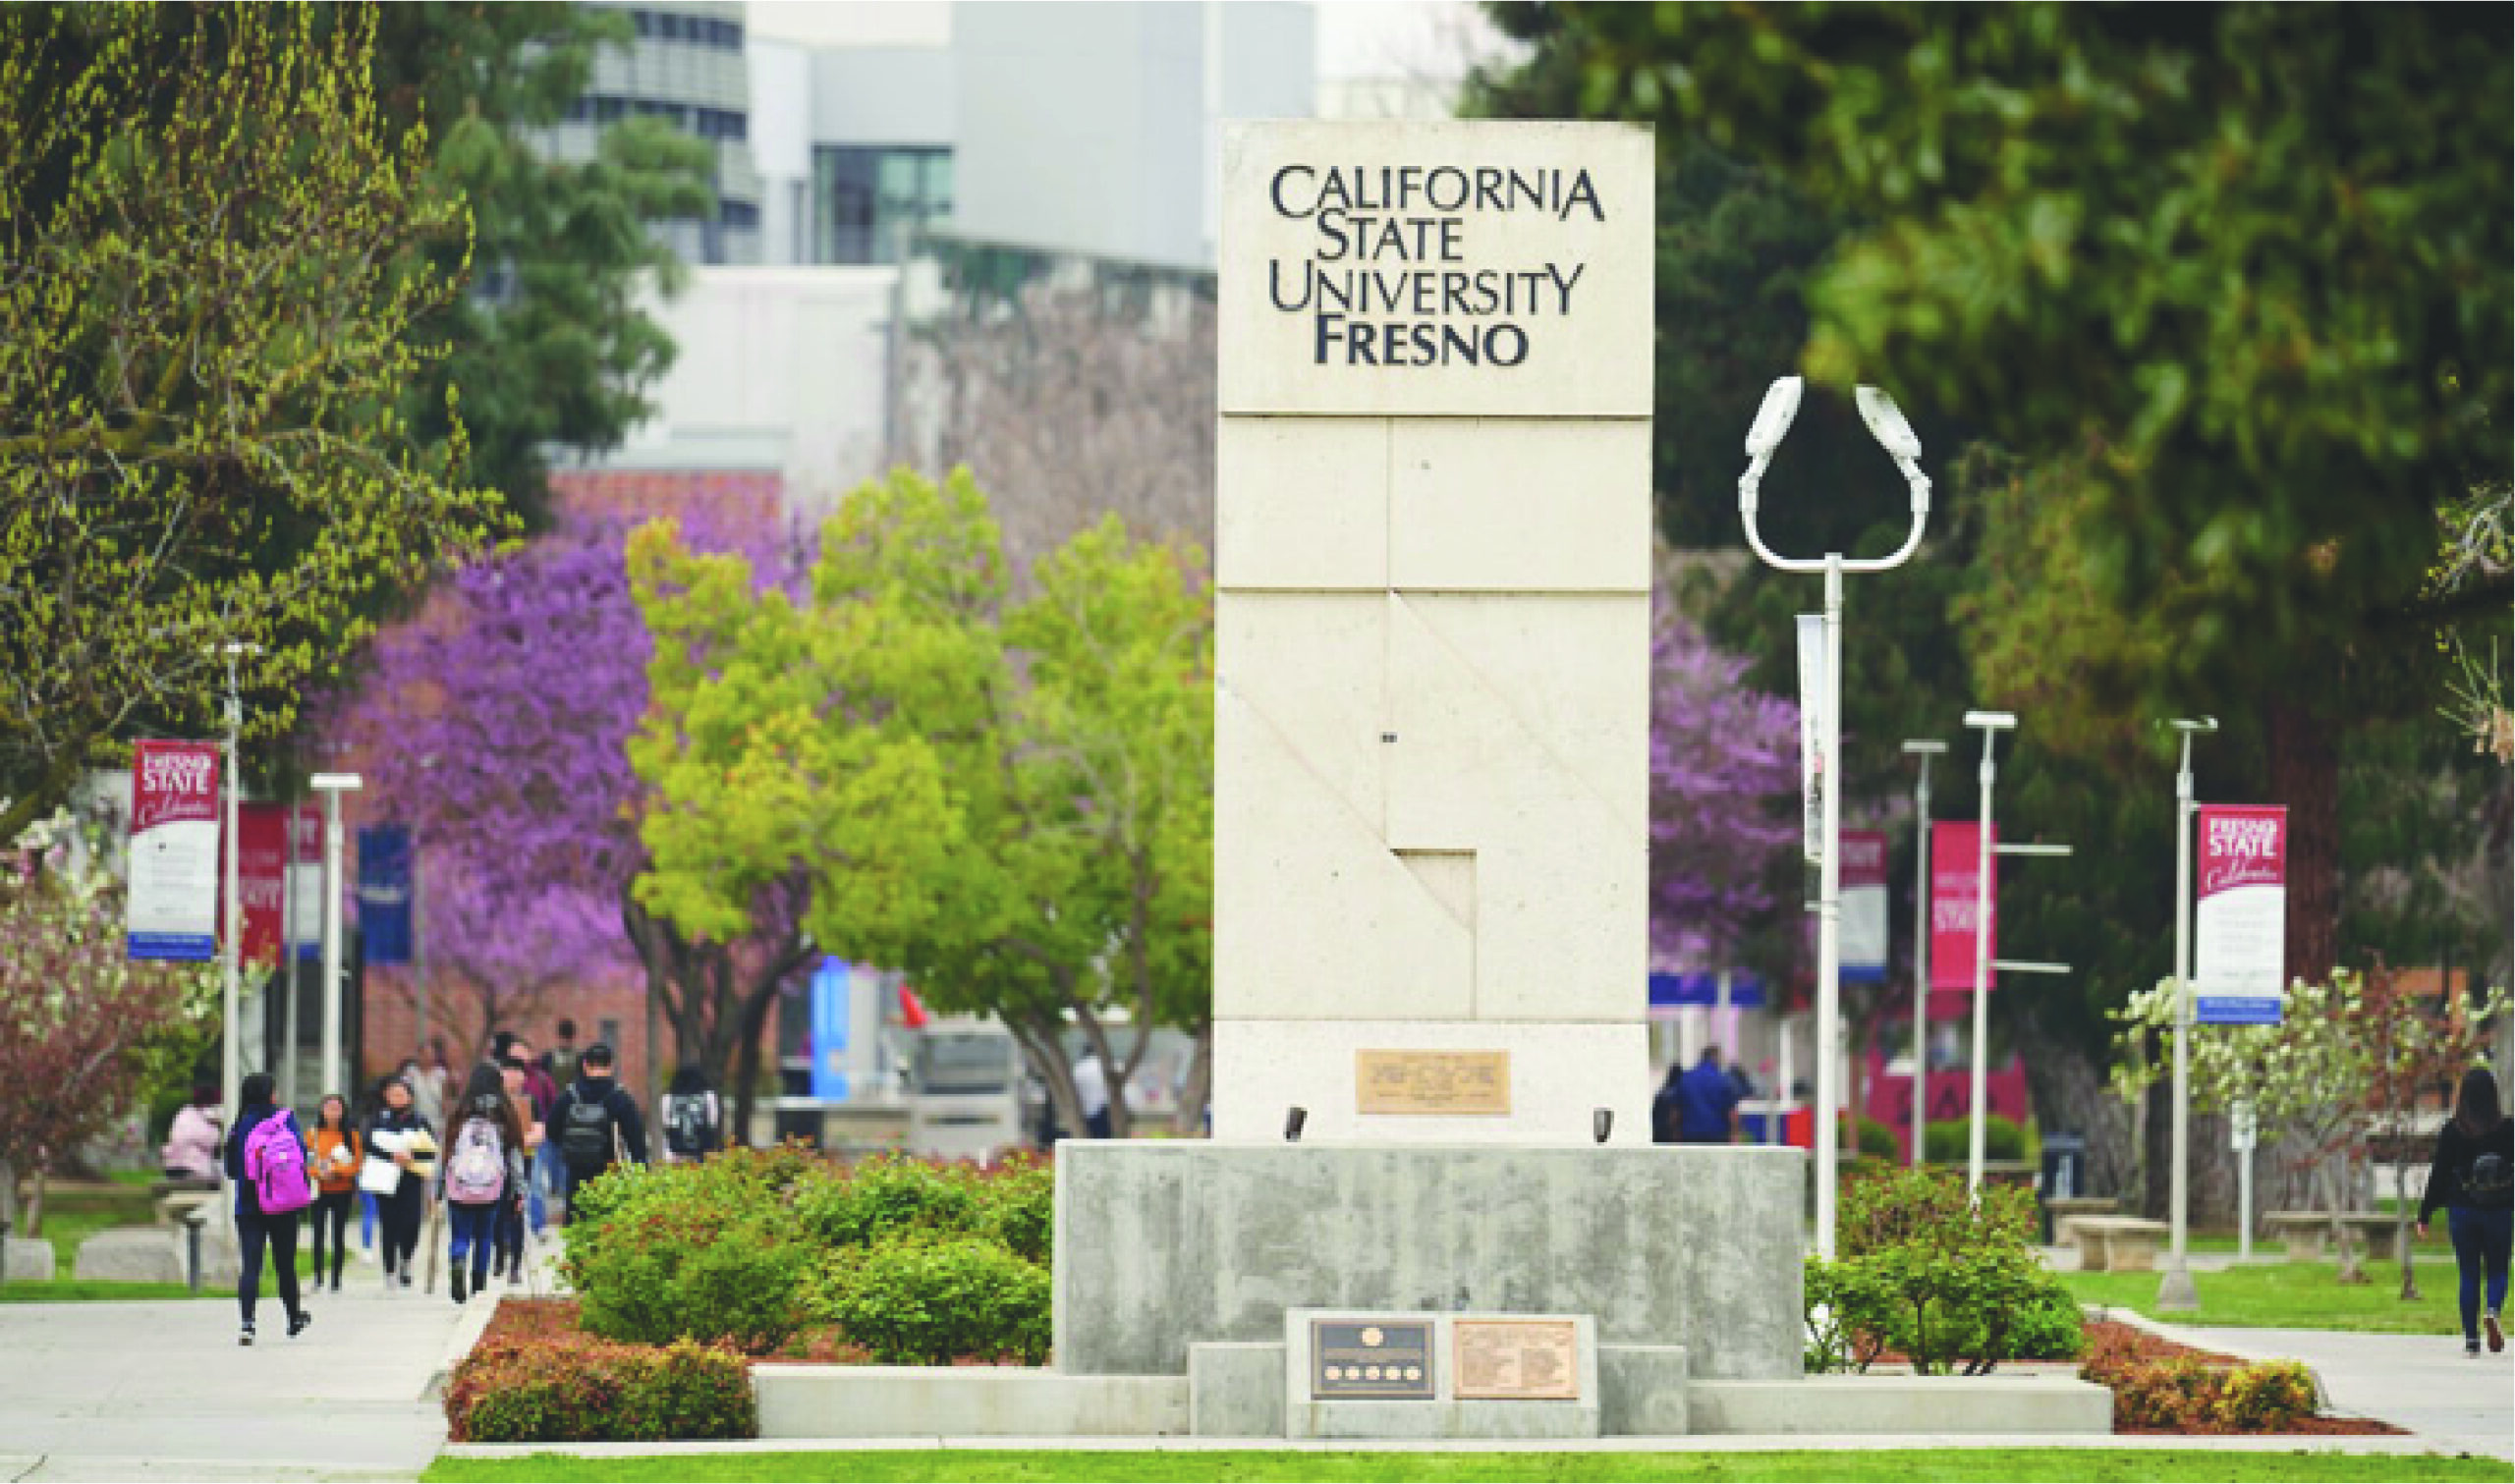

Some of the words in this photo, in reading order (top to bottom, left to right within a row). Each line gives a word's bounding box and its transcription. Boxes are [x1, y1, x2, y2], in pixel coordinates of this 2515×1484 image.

[1268, 163, 1606, 222] CALIFORNIA
[1315, 207, 1464, 261] STATE
[1268, 258, 1586, 315] UNIVERSITY
[1313, 311, 1530, 366] FRESNO
[142, 770, 210, 795] STATE
[2208, 835, 2277, 857] STATE
